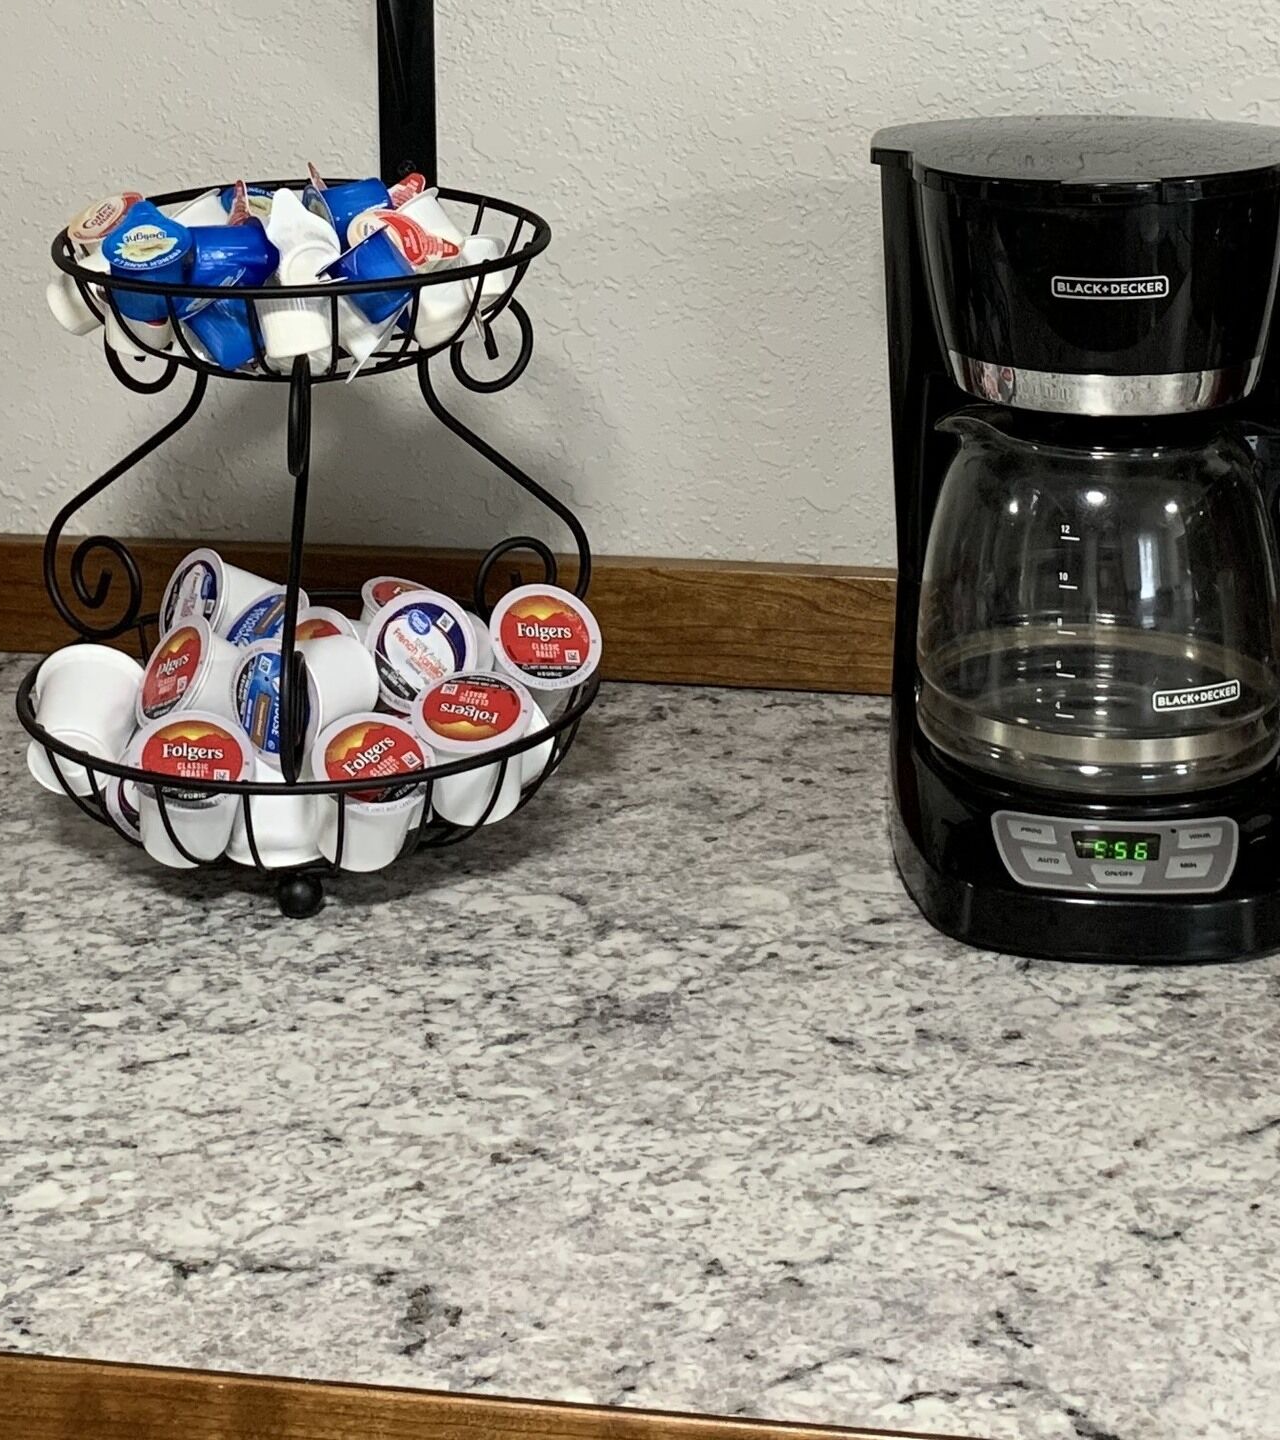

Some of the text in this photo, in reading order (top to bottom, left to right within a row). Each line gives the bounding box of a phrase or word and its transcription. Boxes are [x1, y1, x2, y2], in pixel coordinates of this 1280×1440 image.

[1056, 281, 1164, 294] BLACK+DECKER
[1060, 524, 1070, 534] 12
[1058, 571, 1068, 581] 10
[516, 622, 573, 642] Folgers
[392, 627, 419, 655] French
[1055, 660, 1062, 669] 6
[1157, 685, 1237, 707] BLACK+DECKER
[439, 702, 500, 724] Folgers
[162, 742, 224, 760] Folgers
[342, 736, 396, 777] Folgers
[177, 762, 209, 770] CLASSIC
[1037, 857, 1060, 865] AUTO
